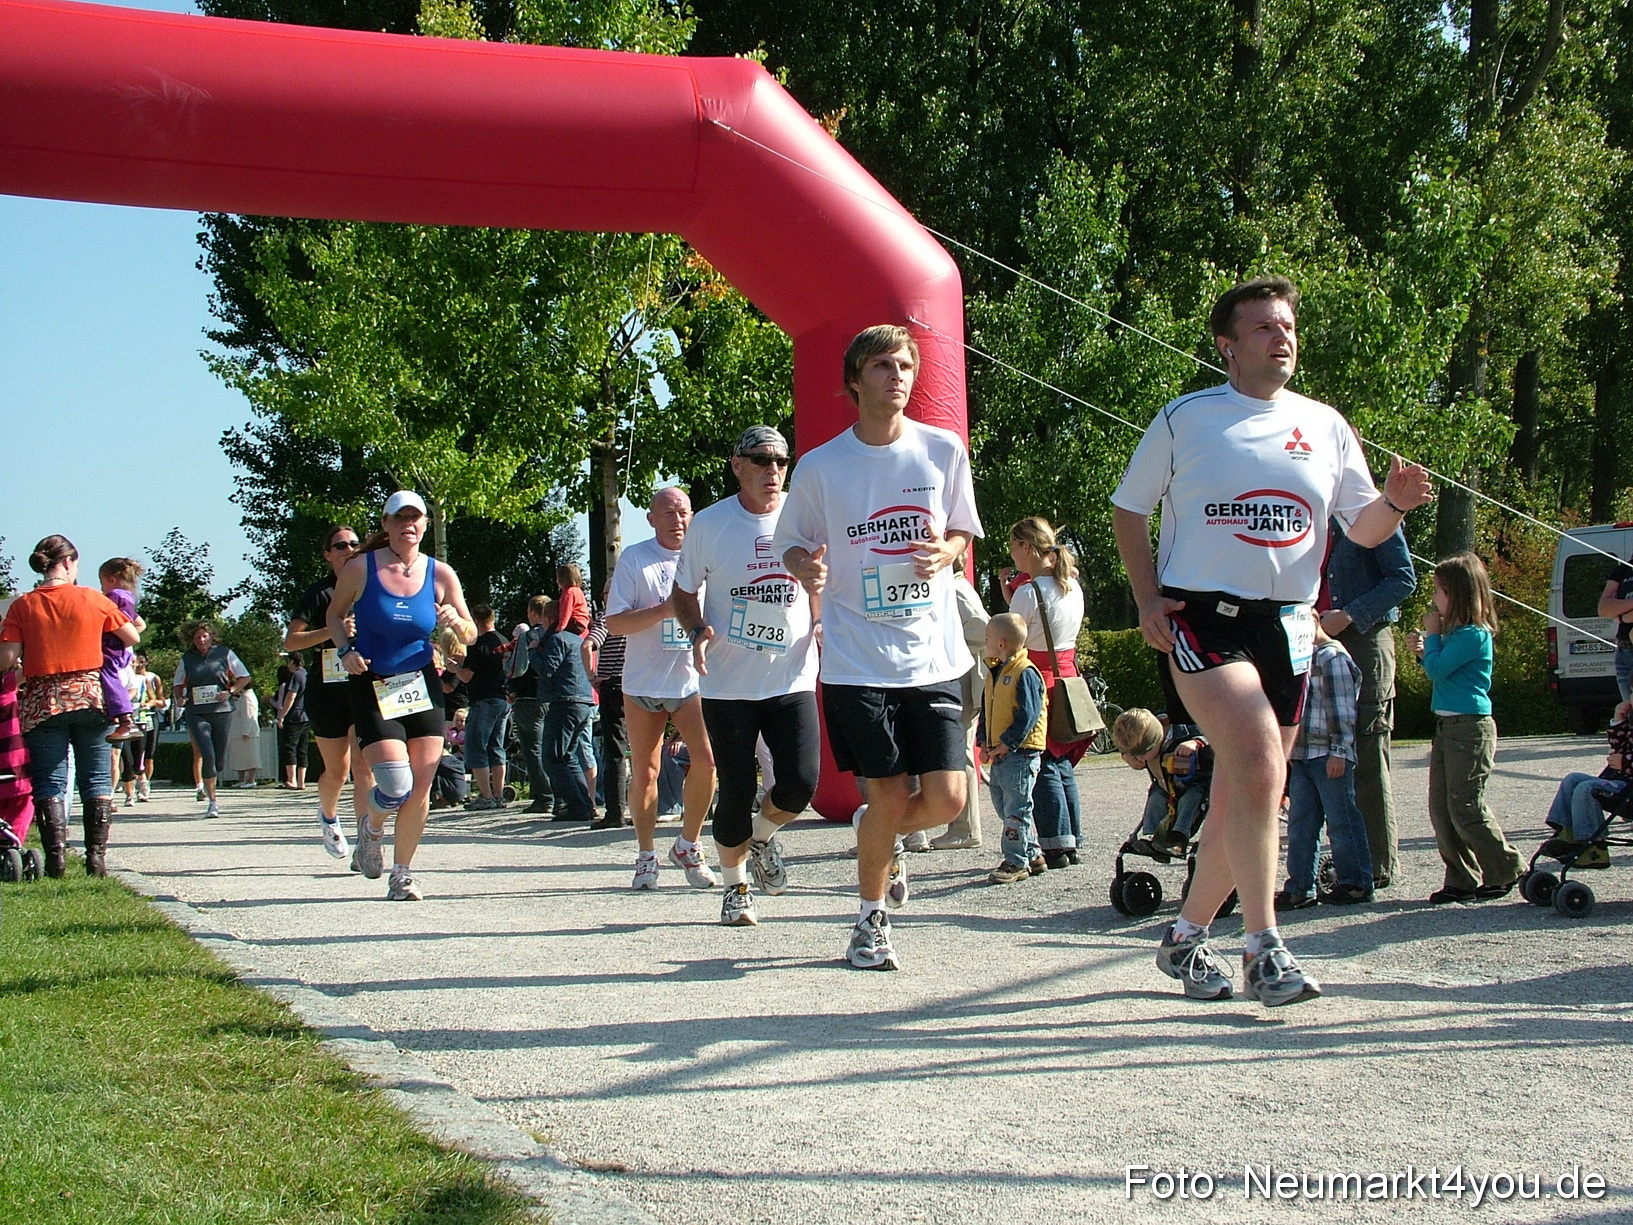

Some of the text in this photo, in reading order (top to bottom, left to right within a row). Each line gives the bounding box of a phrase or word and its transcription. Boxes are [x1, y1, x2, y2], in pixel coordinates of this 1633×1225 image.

[1204, 503, 1302, 518] GERHART &
[846, 515, 920, 538] GERHART
[850, 535, 880, 545] Autohaus
[746, 561, 784, 571] SEA
[730, 584, 789, 597] GERHART
[886, 581, 930, 602] 3739
[746, 623, 785, 642] 3738
[397, 690, 421, 704] 492
